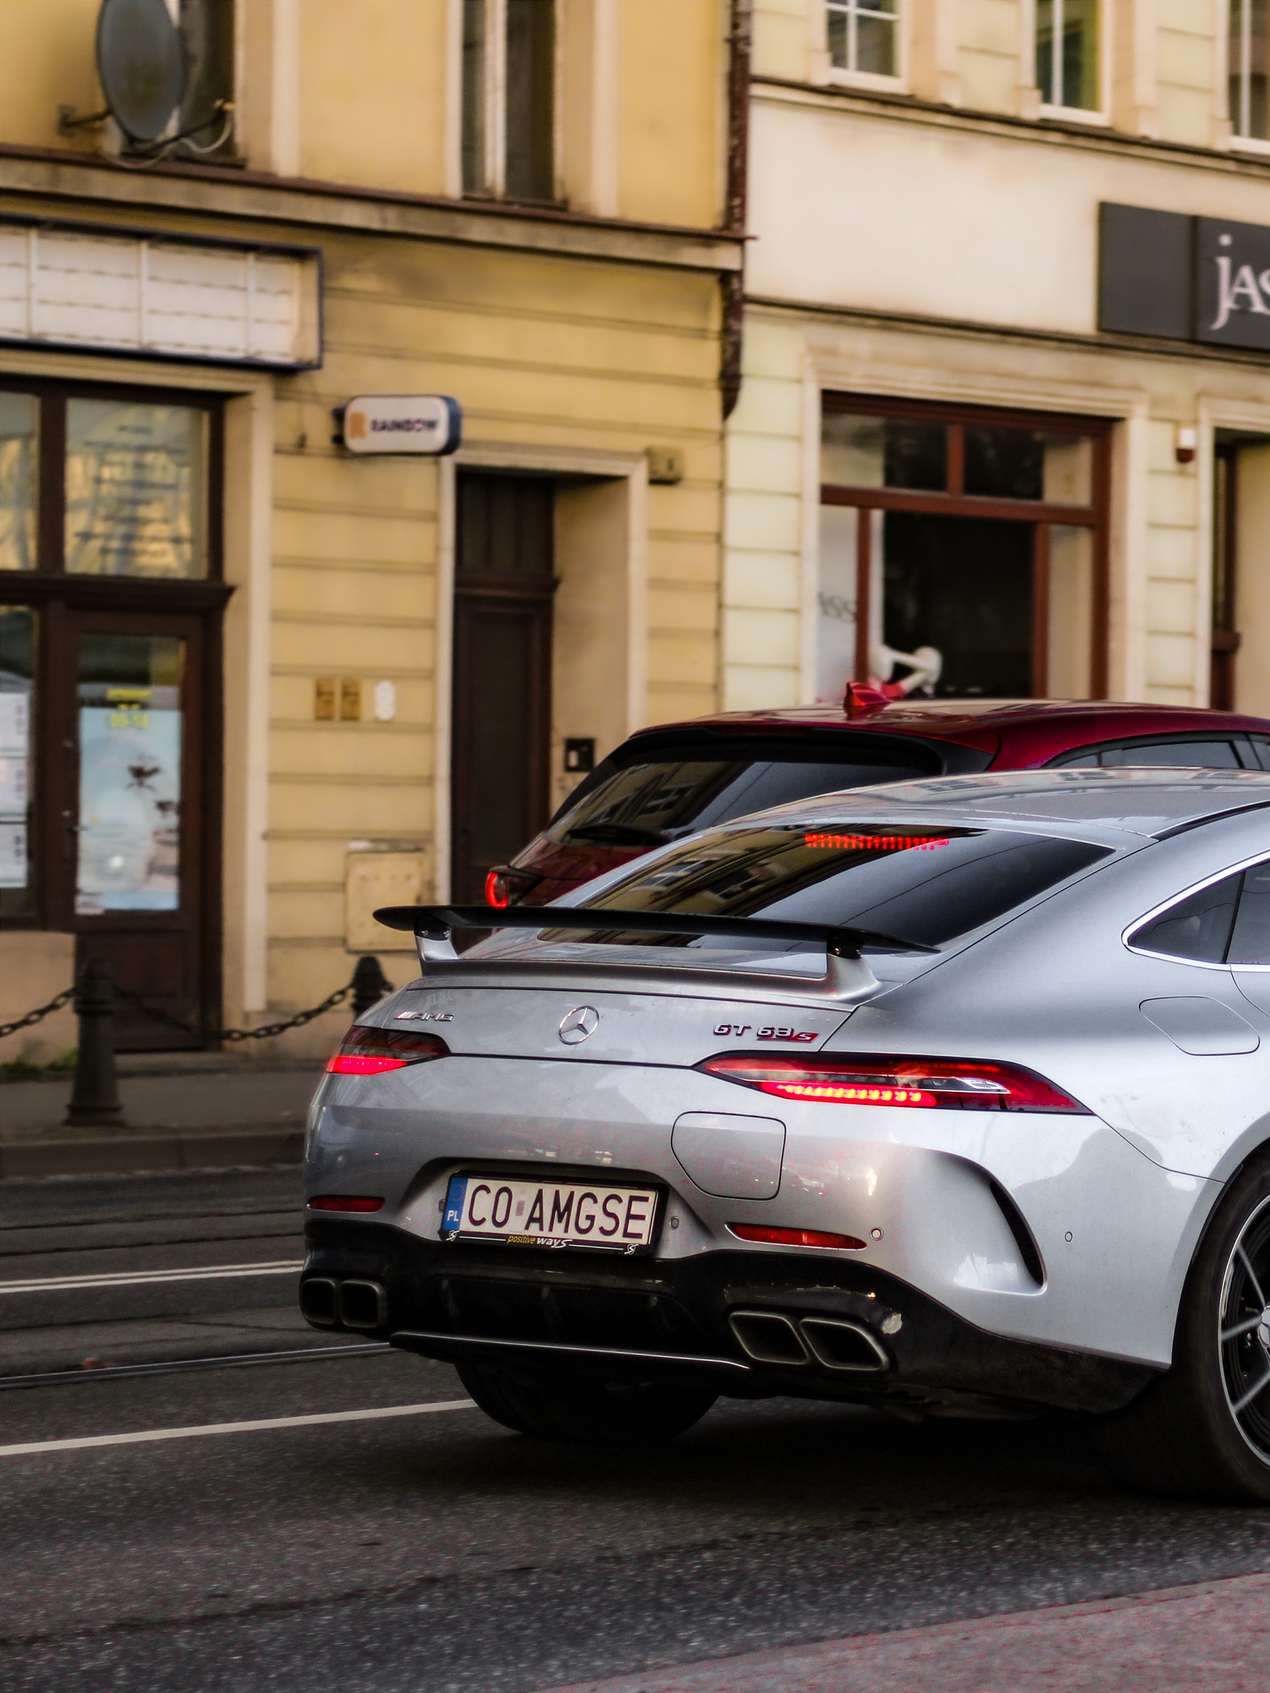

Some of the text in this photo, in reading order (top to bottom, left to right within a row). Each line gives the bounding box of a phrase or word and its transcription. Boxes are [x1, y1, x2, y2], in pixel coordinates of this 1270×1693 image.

[371, 419, 438, 433] RAINBOW
[714, 1024, 751, 1036] GT
[447, 1209, 460, 1222] PL
[524, 1188, 650, 1240] AMGSE
[507, 1234, 573, 1249] positive ways
